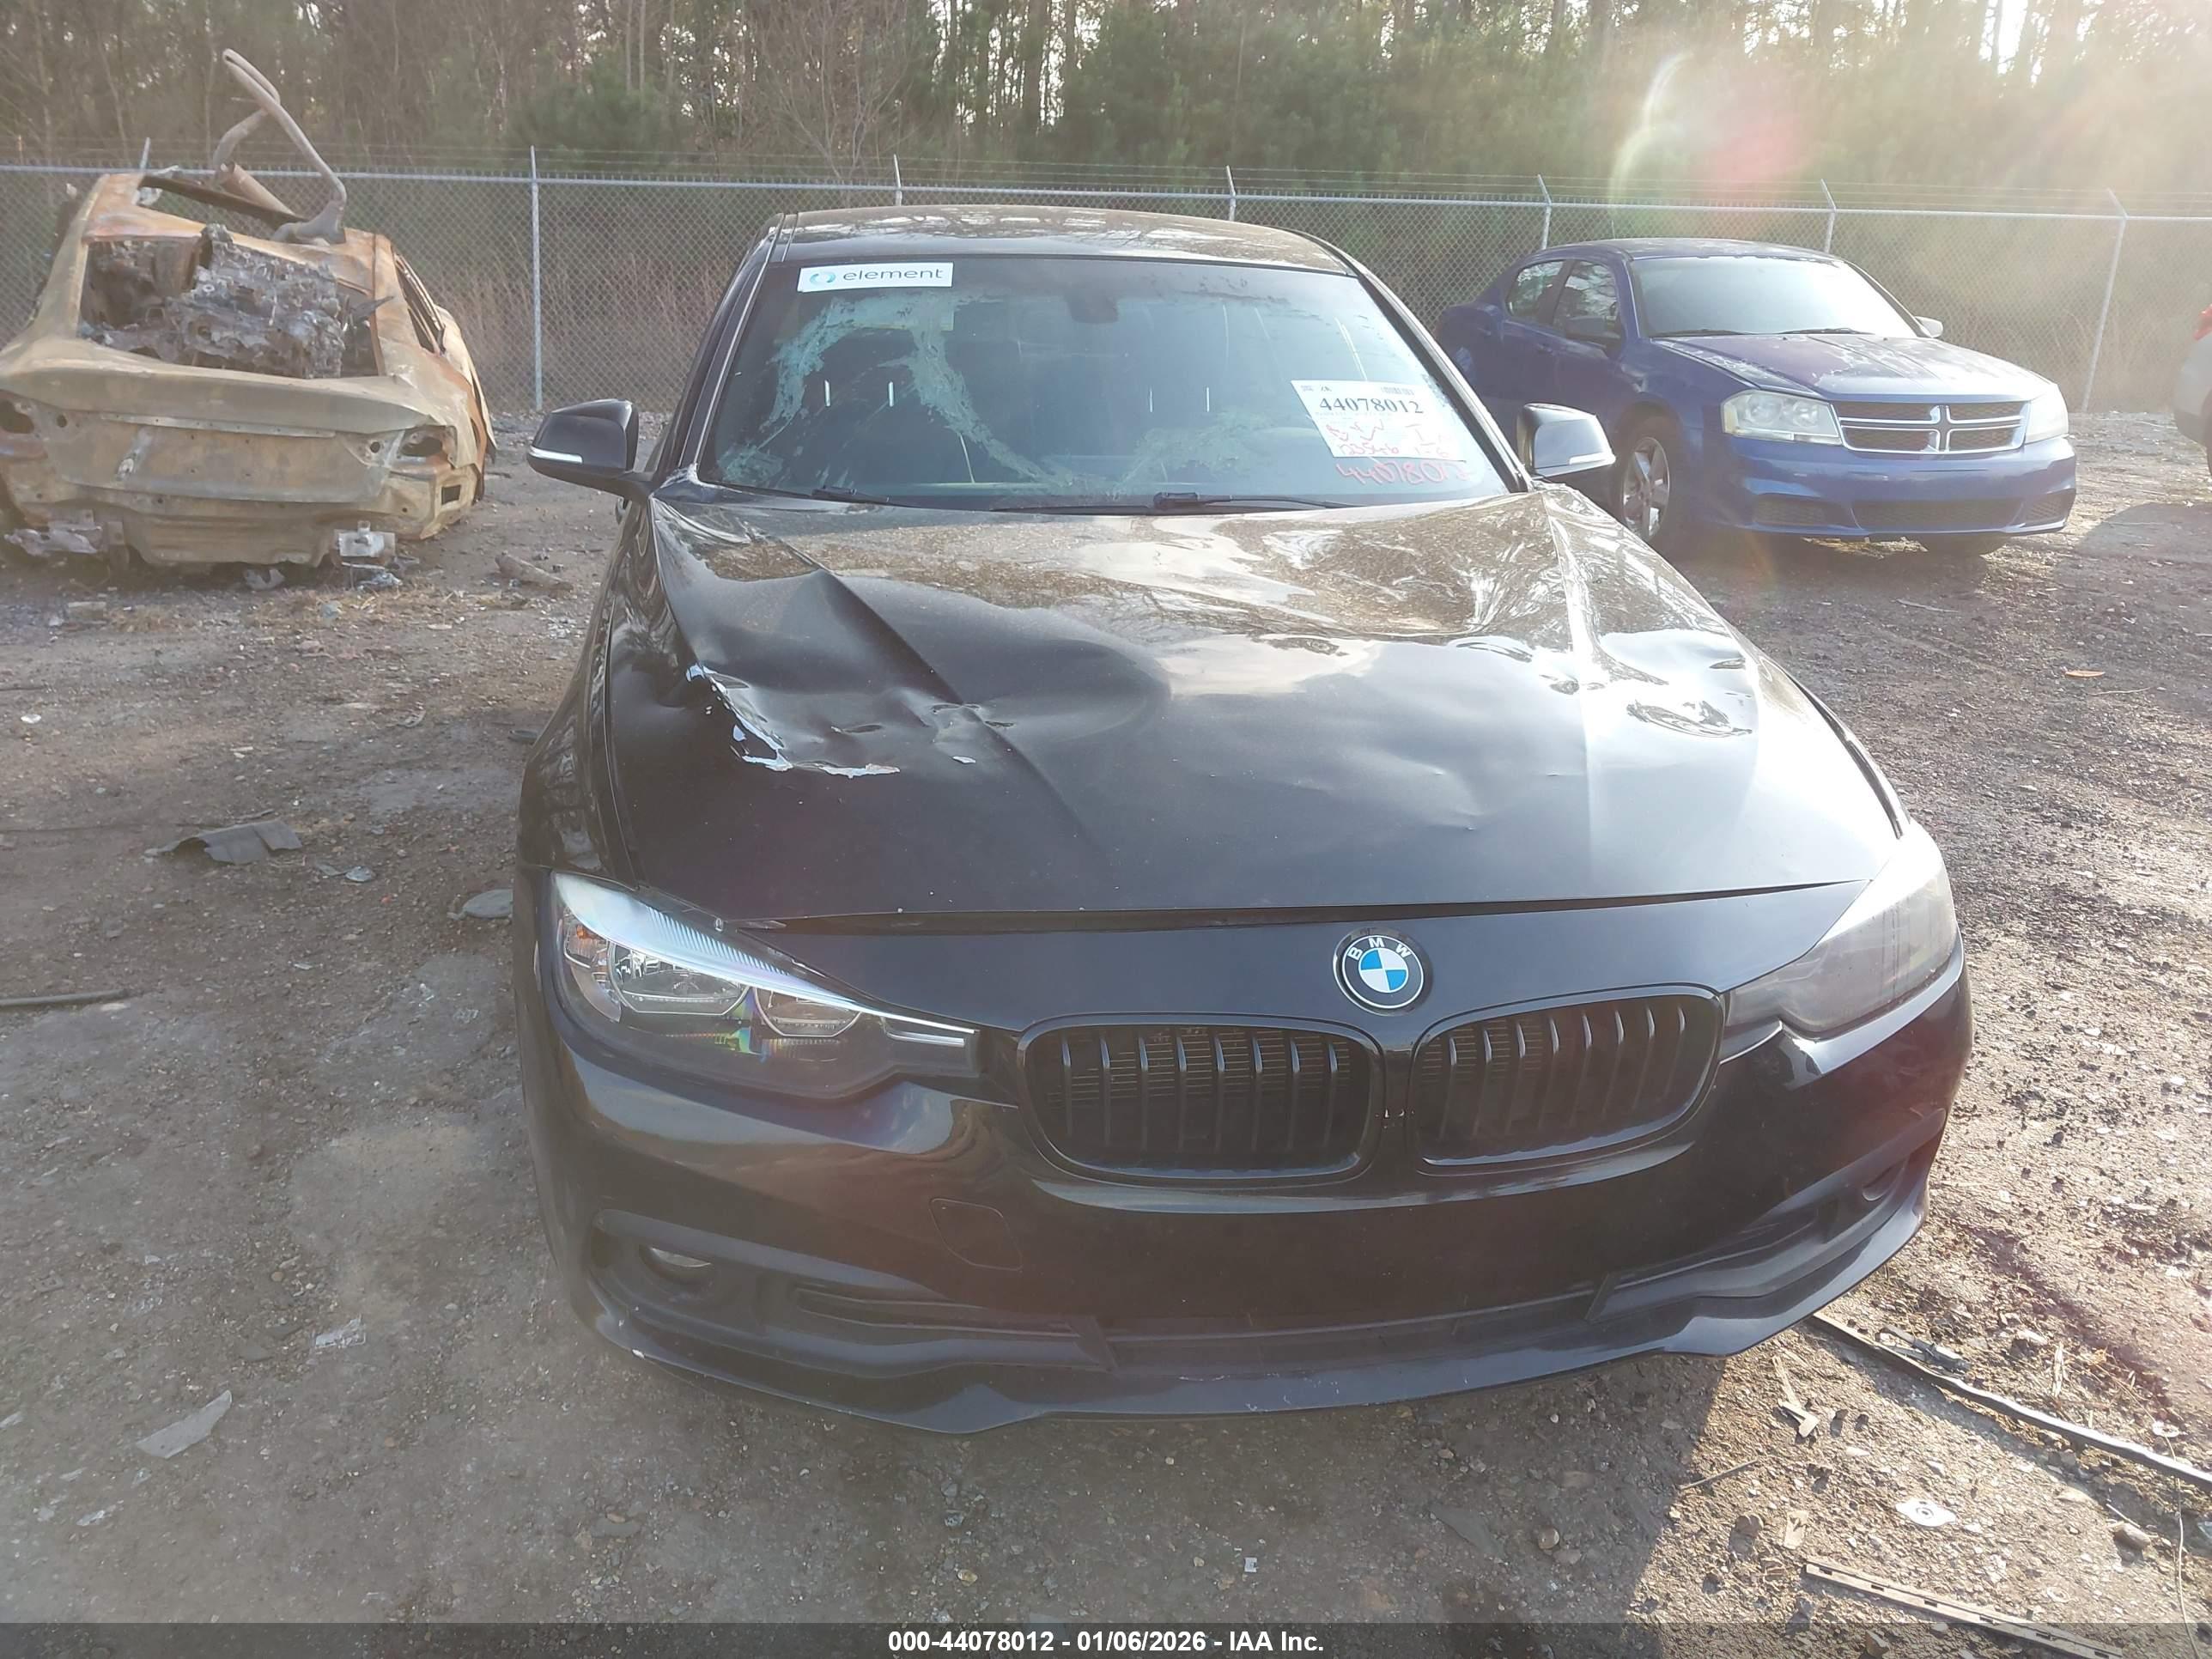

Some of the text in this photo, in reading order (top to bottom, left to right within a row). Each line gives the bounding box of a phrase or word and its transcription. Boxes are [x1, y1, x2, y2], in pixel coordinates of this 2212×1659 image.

[843, 268, 944, 282] element
[1319, 398, 1425, 414] 44078012
[1346, 937, 1413, 961] BMW
